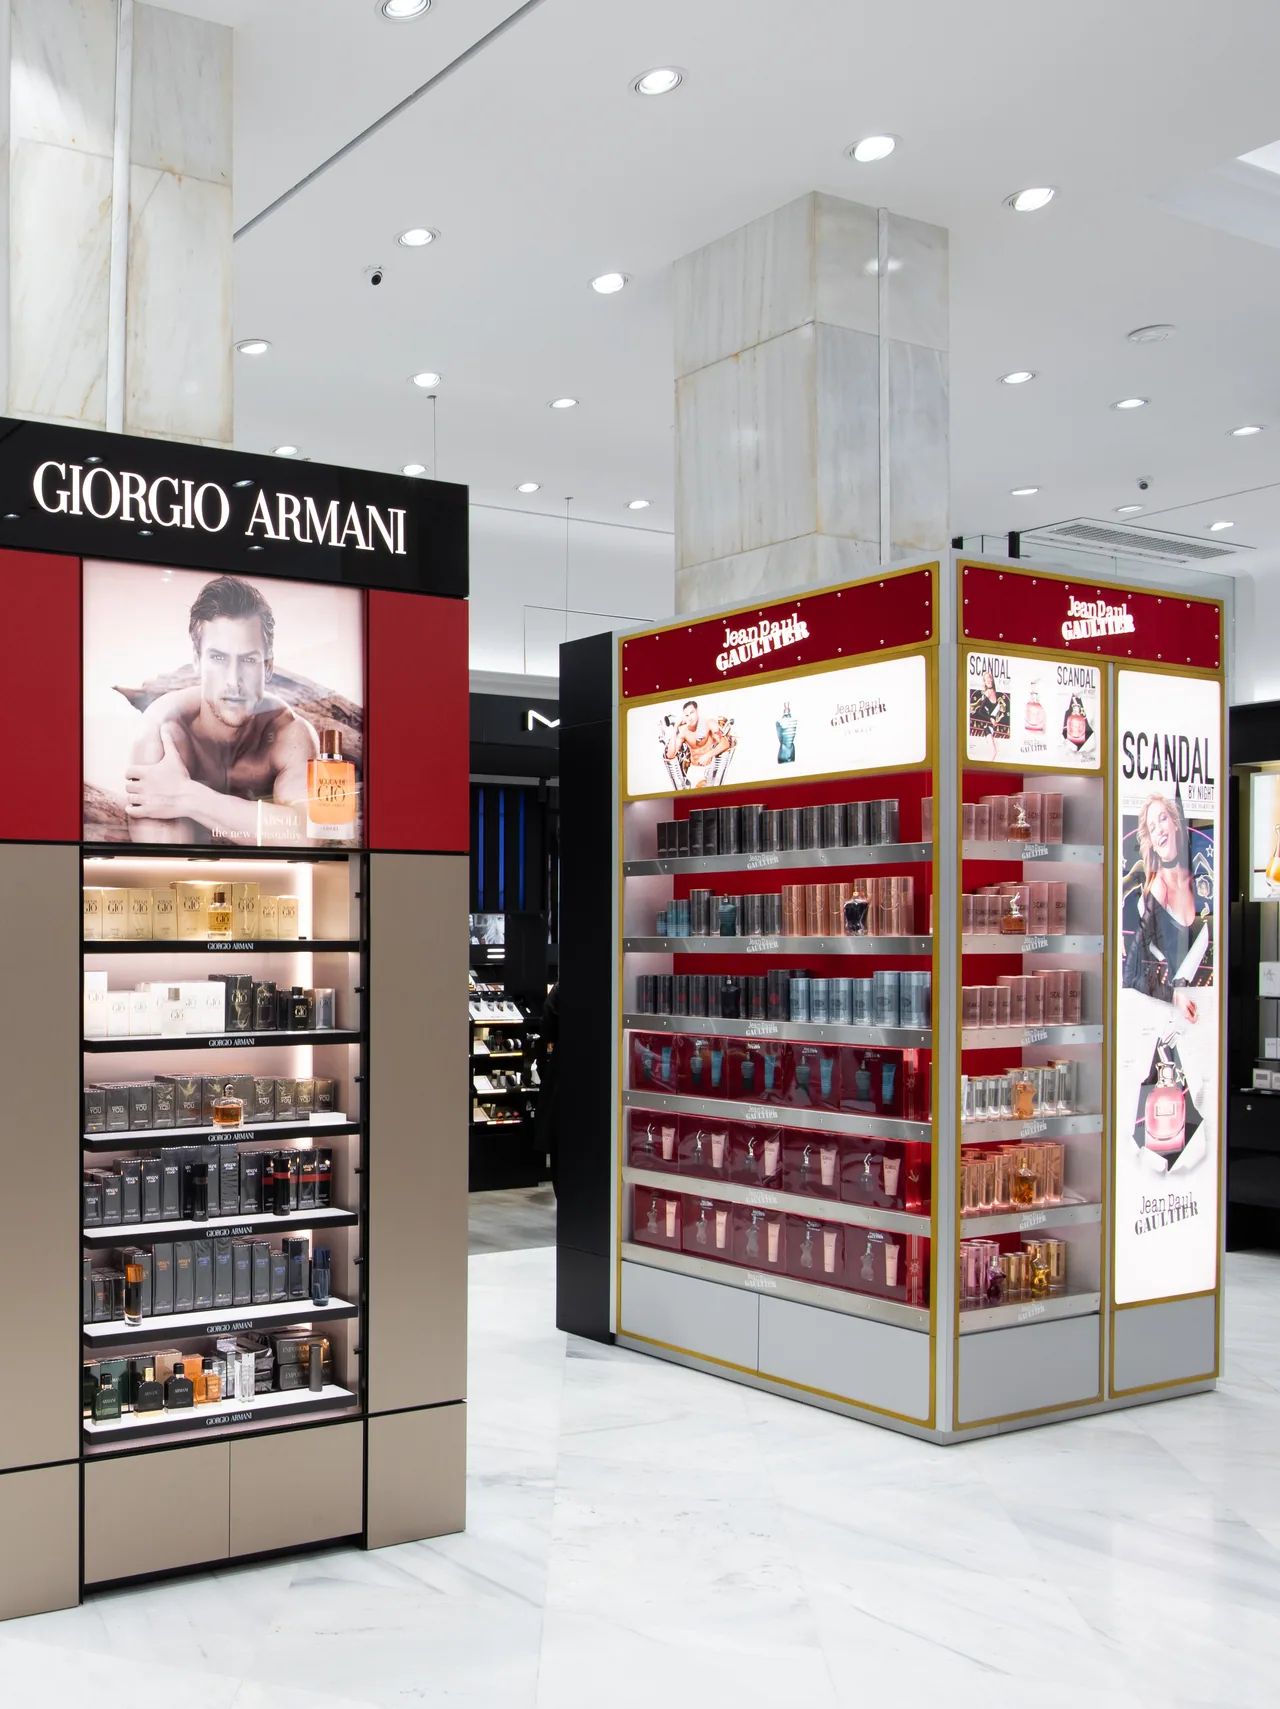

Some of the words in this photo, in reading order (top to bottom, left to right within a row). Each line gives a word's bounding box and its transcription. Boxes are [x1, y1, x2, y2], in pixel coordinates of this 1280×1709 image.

[33, 461, 230, 533] GIORGIO
[245, 488, 407, 555] ARMANI
[1067, 595, 1096, 618] Jean
[1096, 600, 1127, 618] Paul
[723, 627, 758, 648] Jean
[758, 613, 798, 638] Paul
[1061, 614, 1135, 640] GAULTIER
[715, 621, 810, 671] GAULTIER
[969, 656, 1011, 680] SCANDAL
[1057, 666, 1096, 689] SCANDAL
[831, 703, 887, 727] GAULTIER
[835, 704, 857, 715] Jean
[859, 697, 880, 712] Paul
[1123, 731, 1214, 785] SCANDAL
[1189, 785, 1196, 799] BY
[1197, 785, 1214, 800] NIGHT
[211, 828, 228, 838] the
[1140, 1196, 1166, 1215] Jean
[1168, 1192, 1193, 1210] Paul
[1134, 1201, 1198, 1235] GAULTIER
